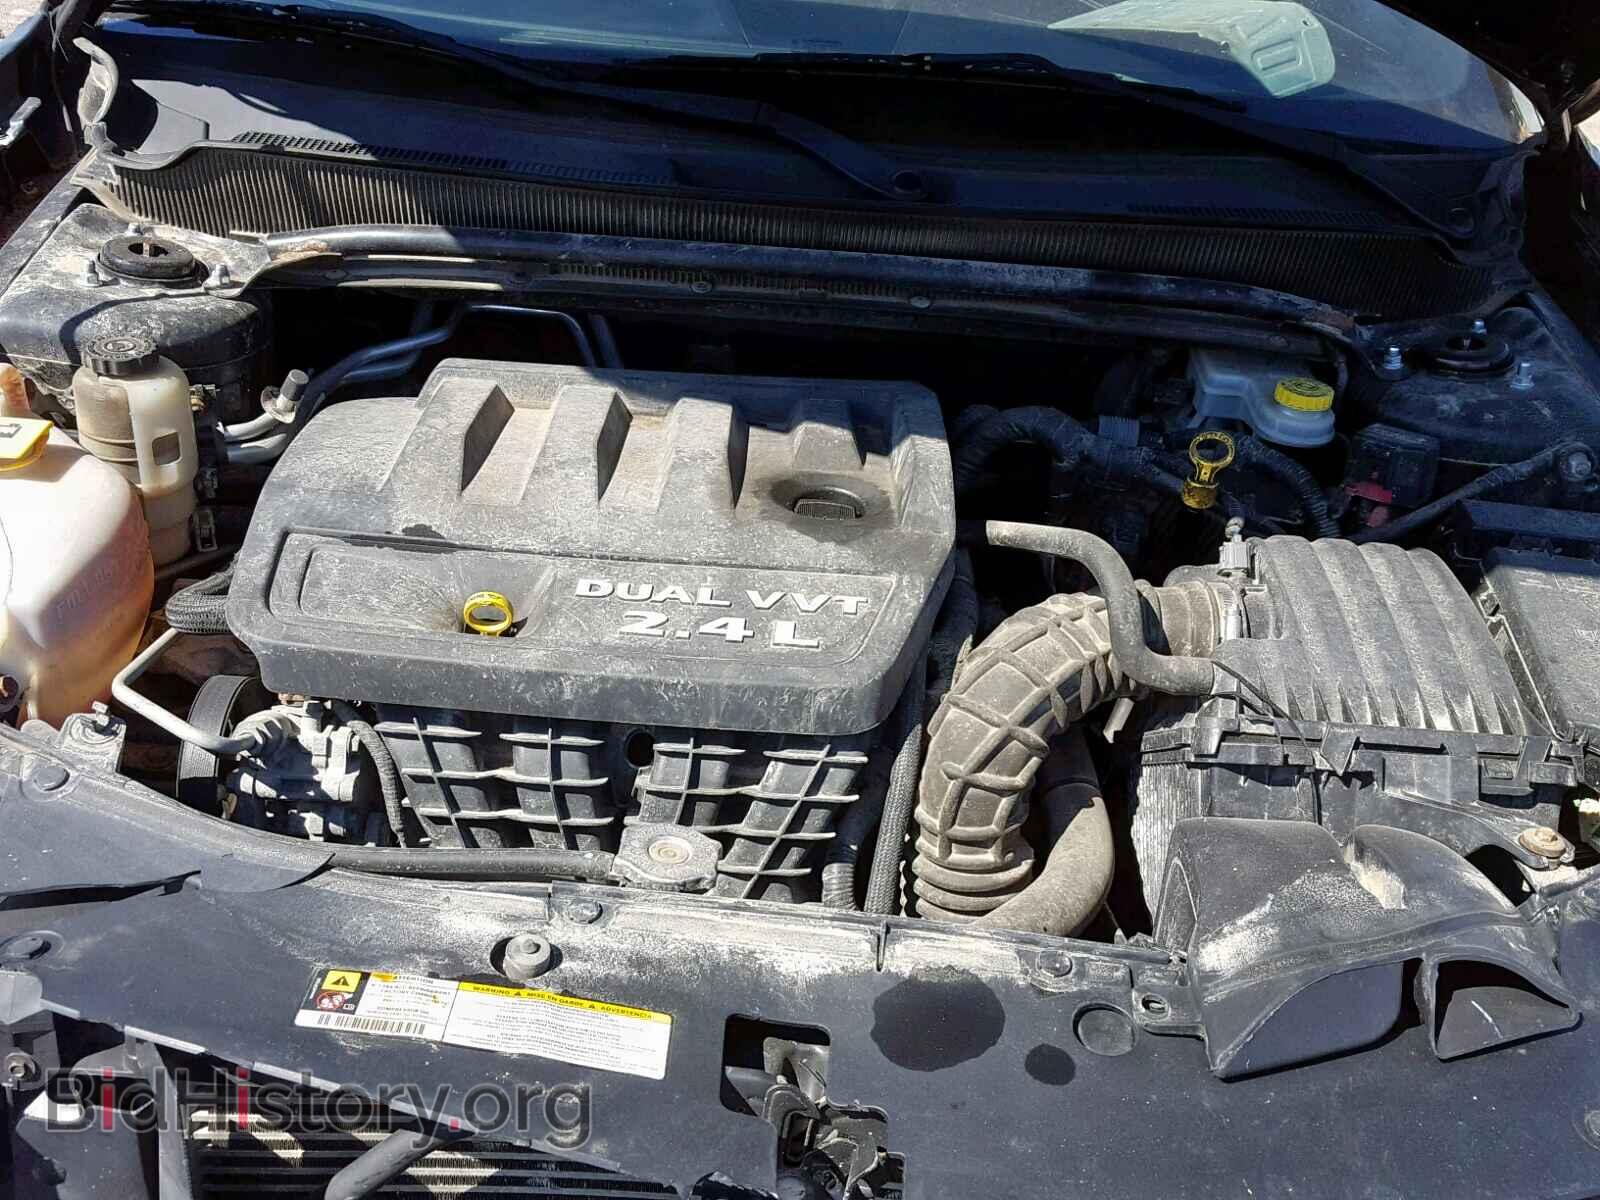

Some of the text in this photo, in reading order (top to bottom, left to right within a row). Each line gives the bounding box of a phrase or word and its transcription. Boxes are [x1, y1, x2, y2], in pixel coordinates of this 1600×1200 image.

[574, 578, 869, 616] DUAL VVT
[619, 610, 821, 648] 2.4 L
[473, 986, 511, 996] WARNING
